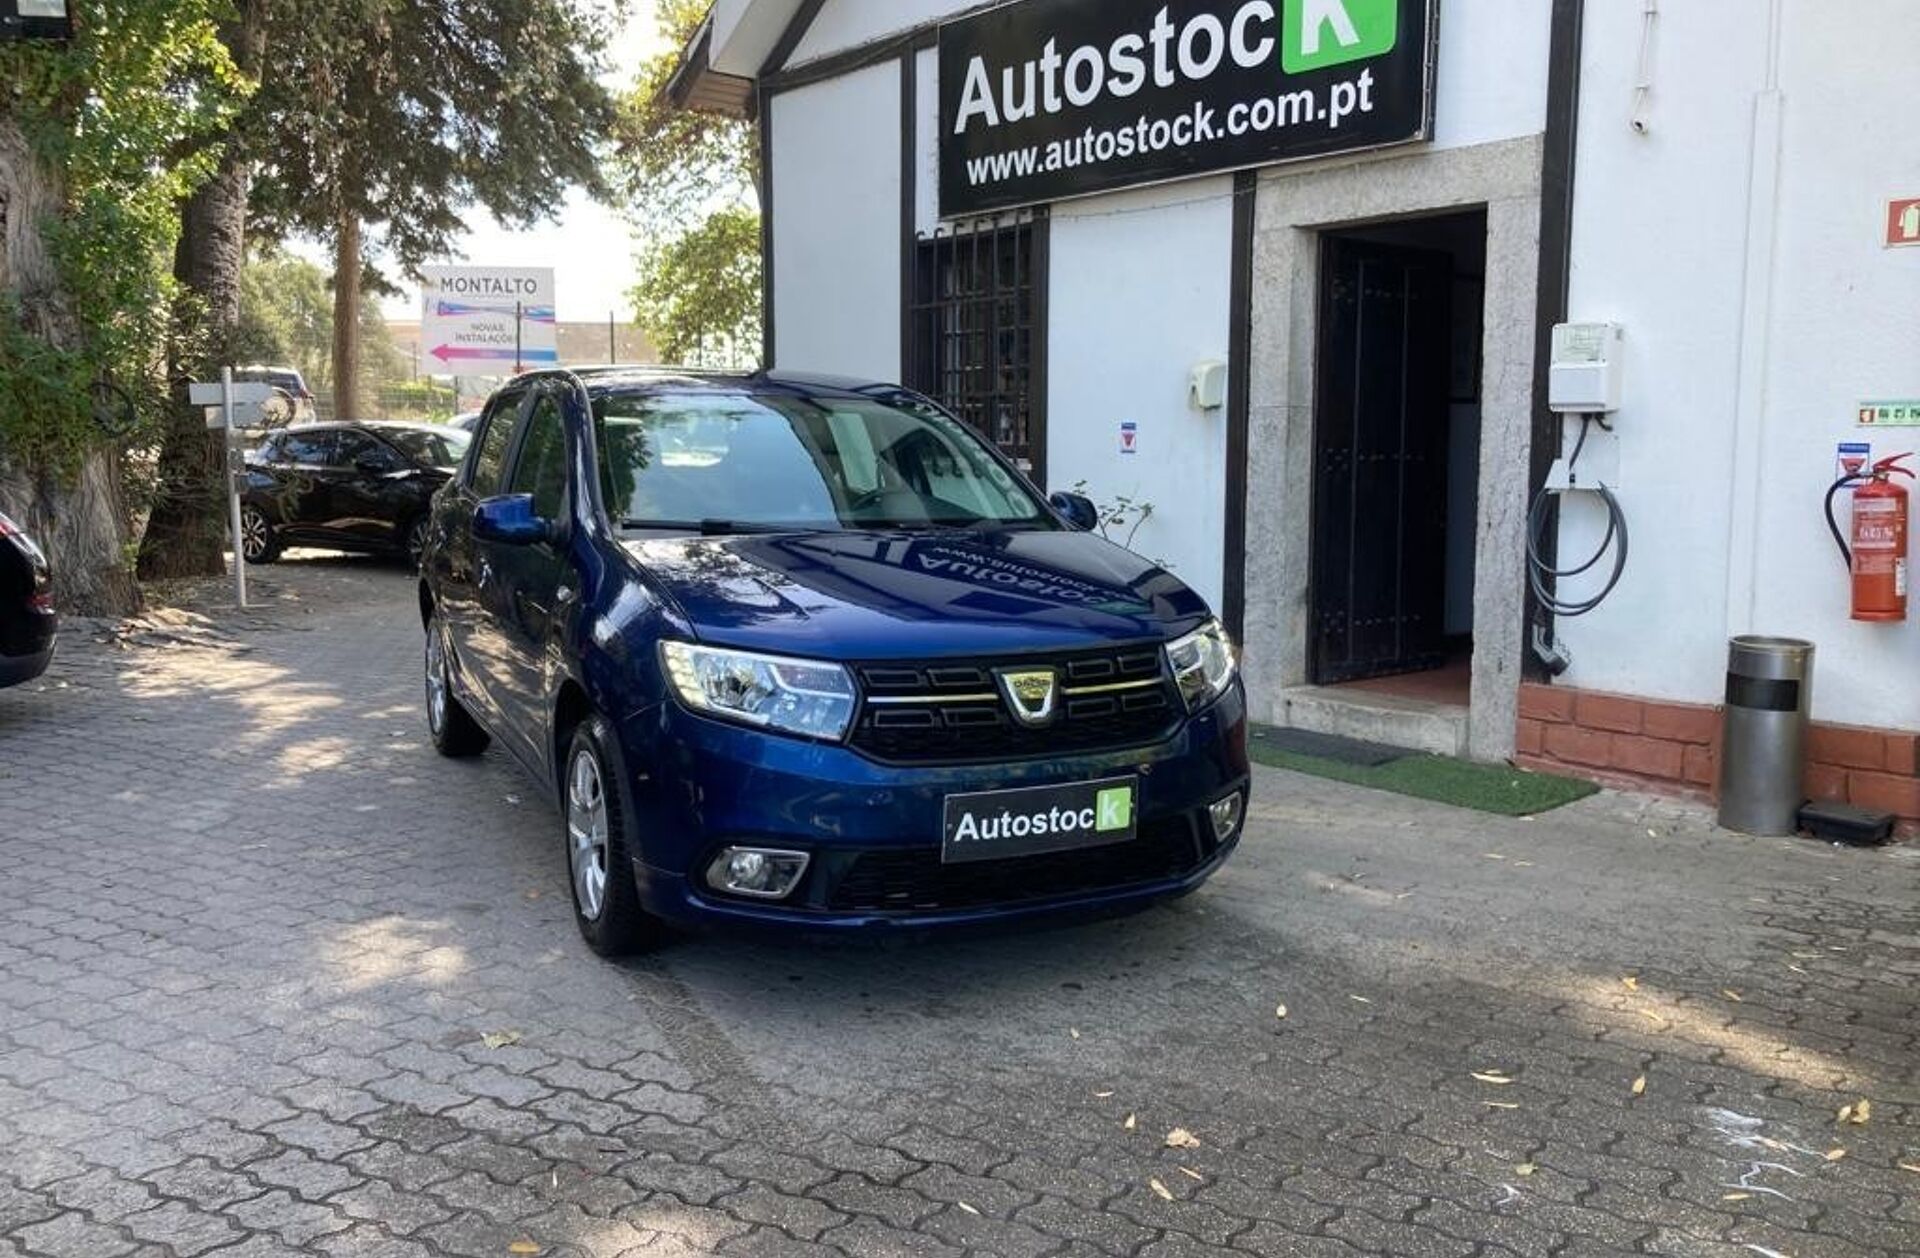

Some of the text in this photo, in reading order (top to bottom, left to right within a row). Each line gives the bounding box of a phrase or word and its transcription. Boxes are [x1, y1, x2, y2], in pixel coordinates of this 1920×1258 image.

[966, 67, 1375, 186] www.autostock.com.pt
[440, 277, 537, 294] MONTALTO
[954, 793, 1119, 842] Autostock
